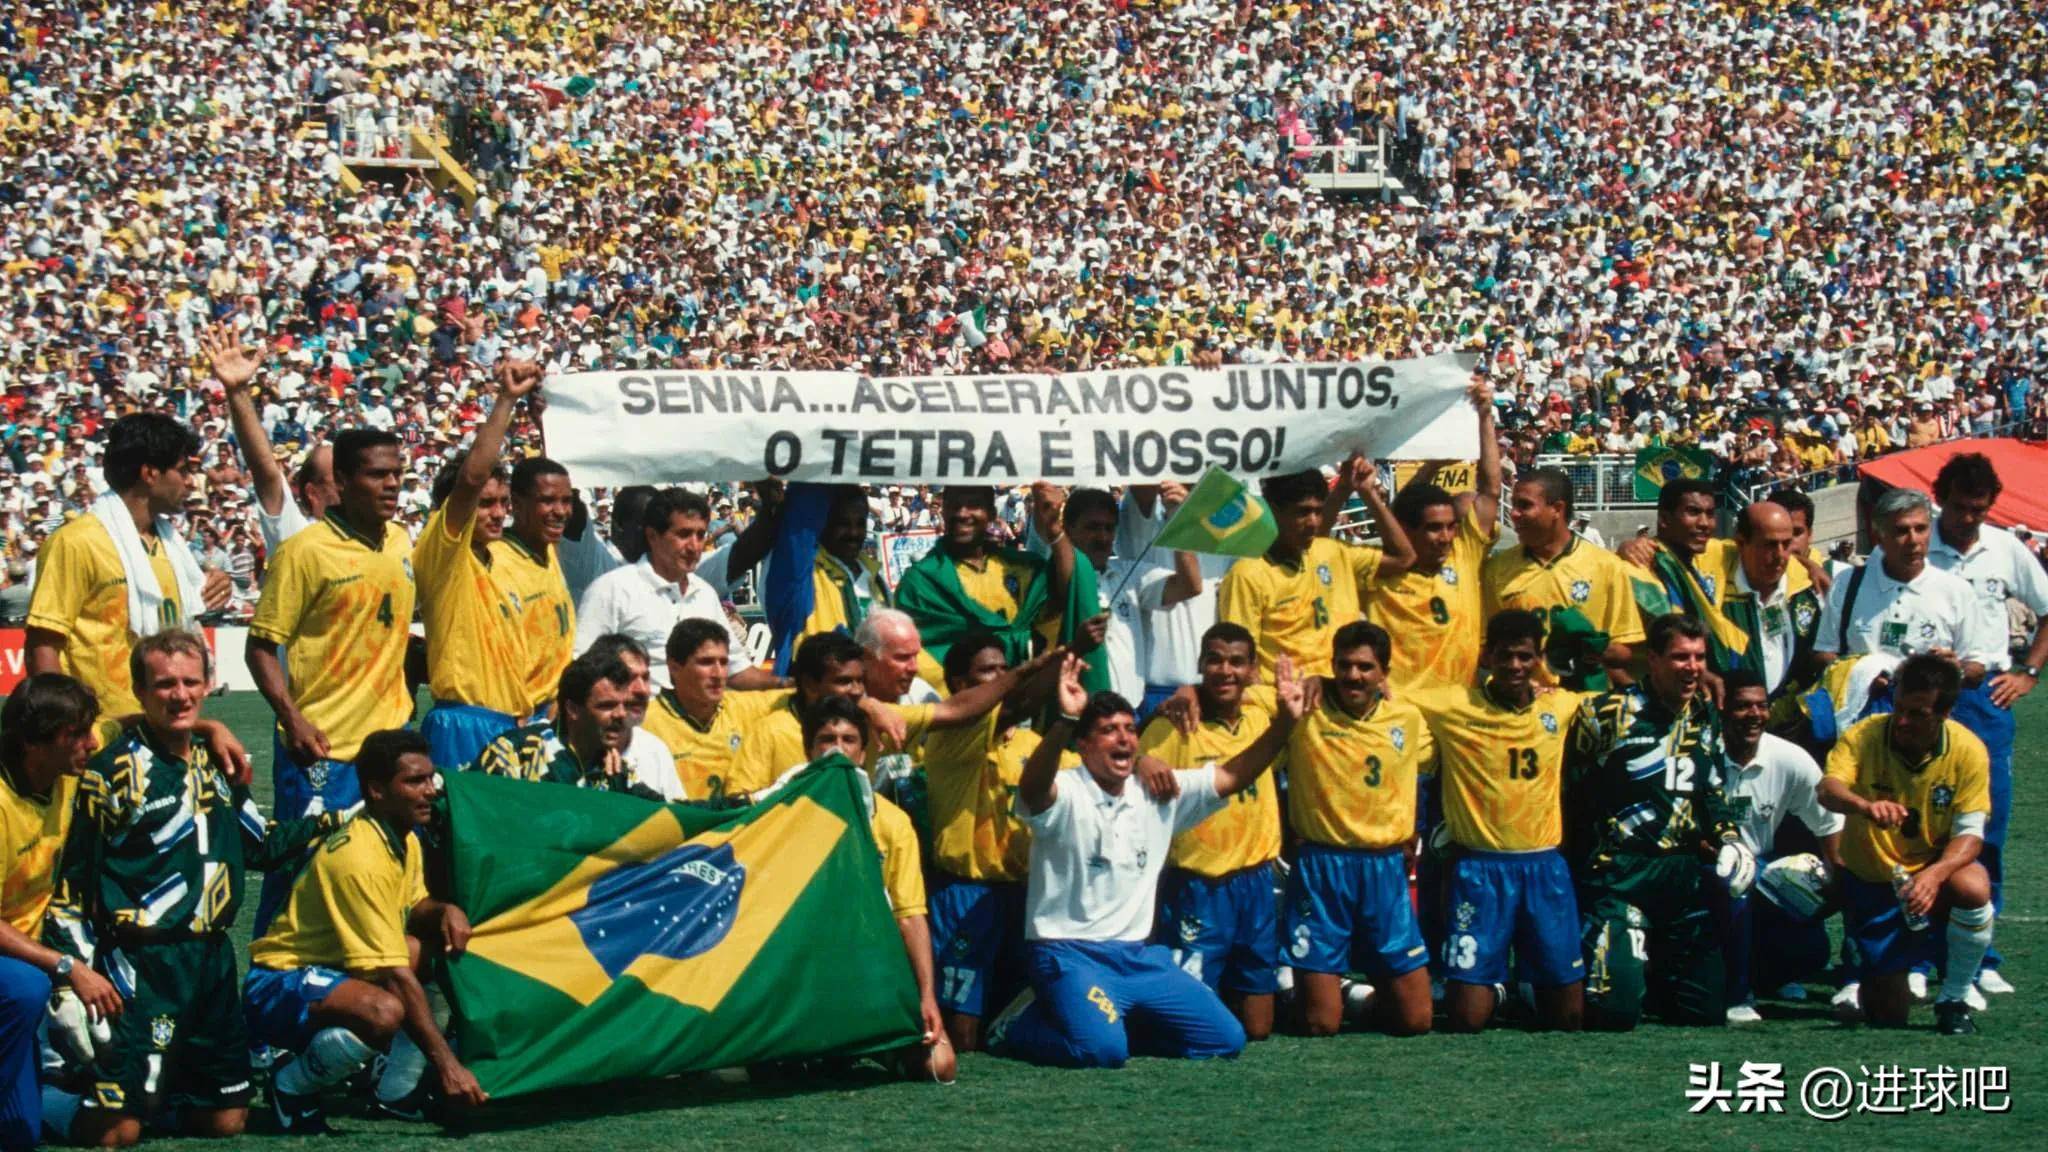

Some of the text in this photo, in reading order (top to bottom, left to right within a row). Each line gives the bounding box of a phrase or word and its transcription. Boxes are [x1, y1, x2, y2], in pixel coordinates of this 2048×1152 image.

[1212, 366, 1399, 412] JUNTOS,
[764, 418, 1287, 478] O TETRA É NOSSO!
[377, 593, 394, 628] 4
[1429, 595, 1451, 625] 9
[1363, 754, 1382, 788] 3
[1507, 747, 1539, 780] 13
[1665, 756, 1695, 791] 12
[144, 795, 177, 813] MBRO
[194, 812, 209, 856] 1
[1292, 924, 1311, 959] 3
[942, 965, 977, 1004] 17
